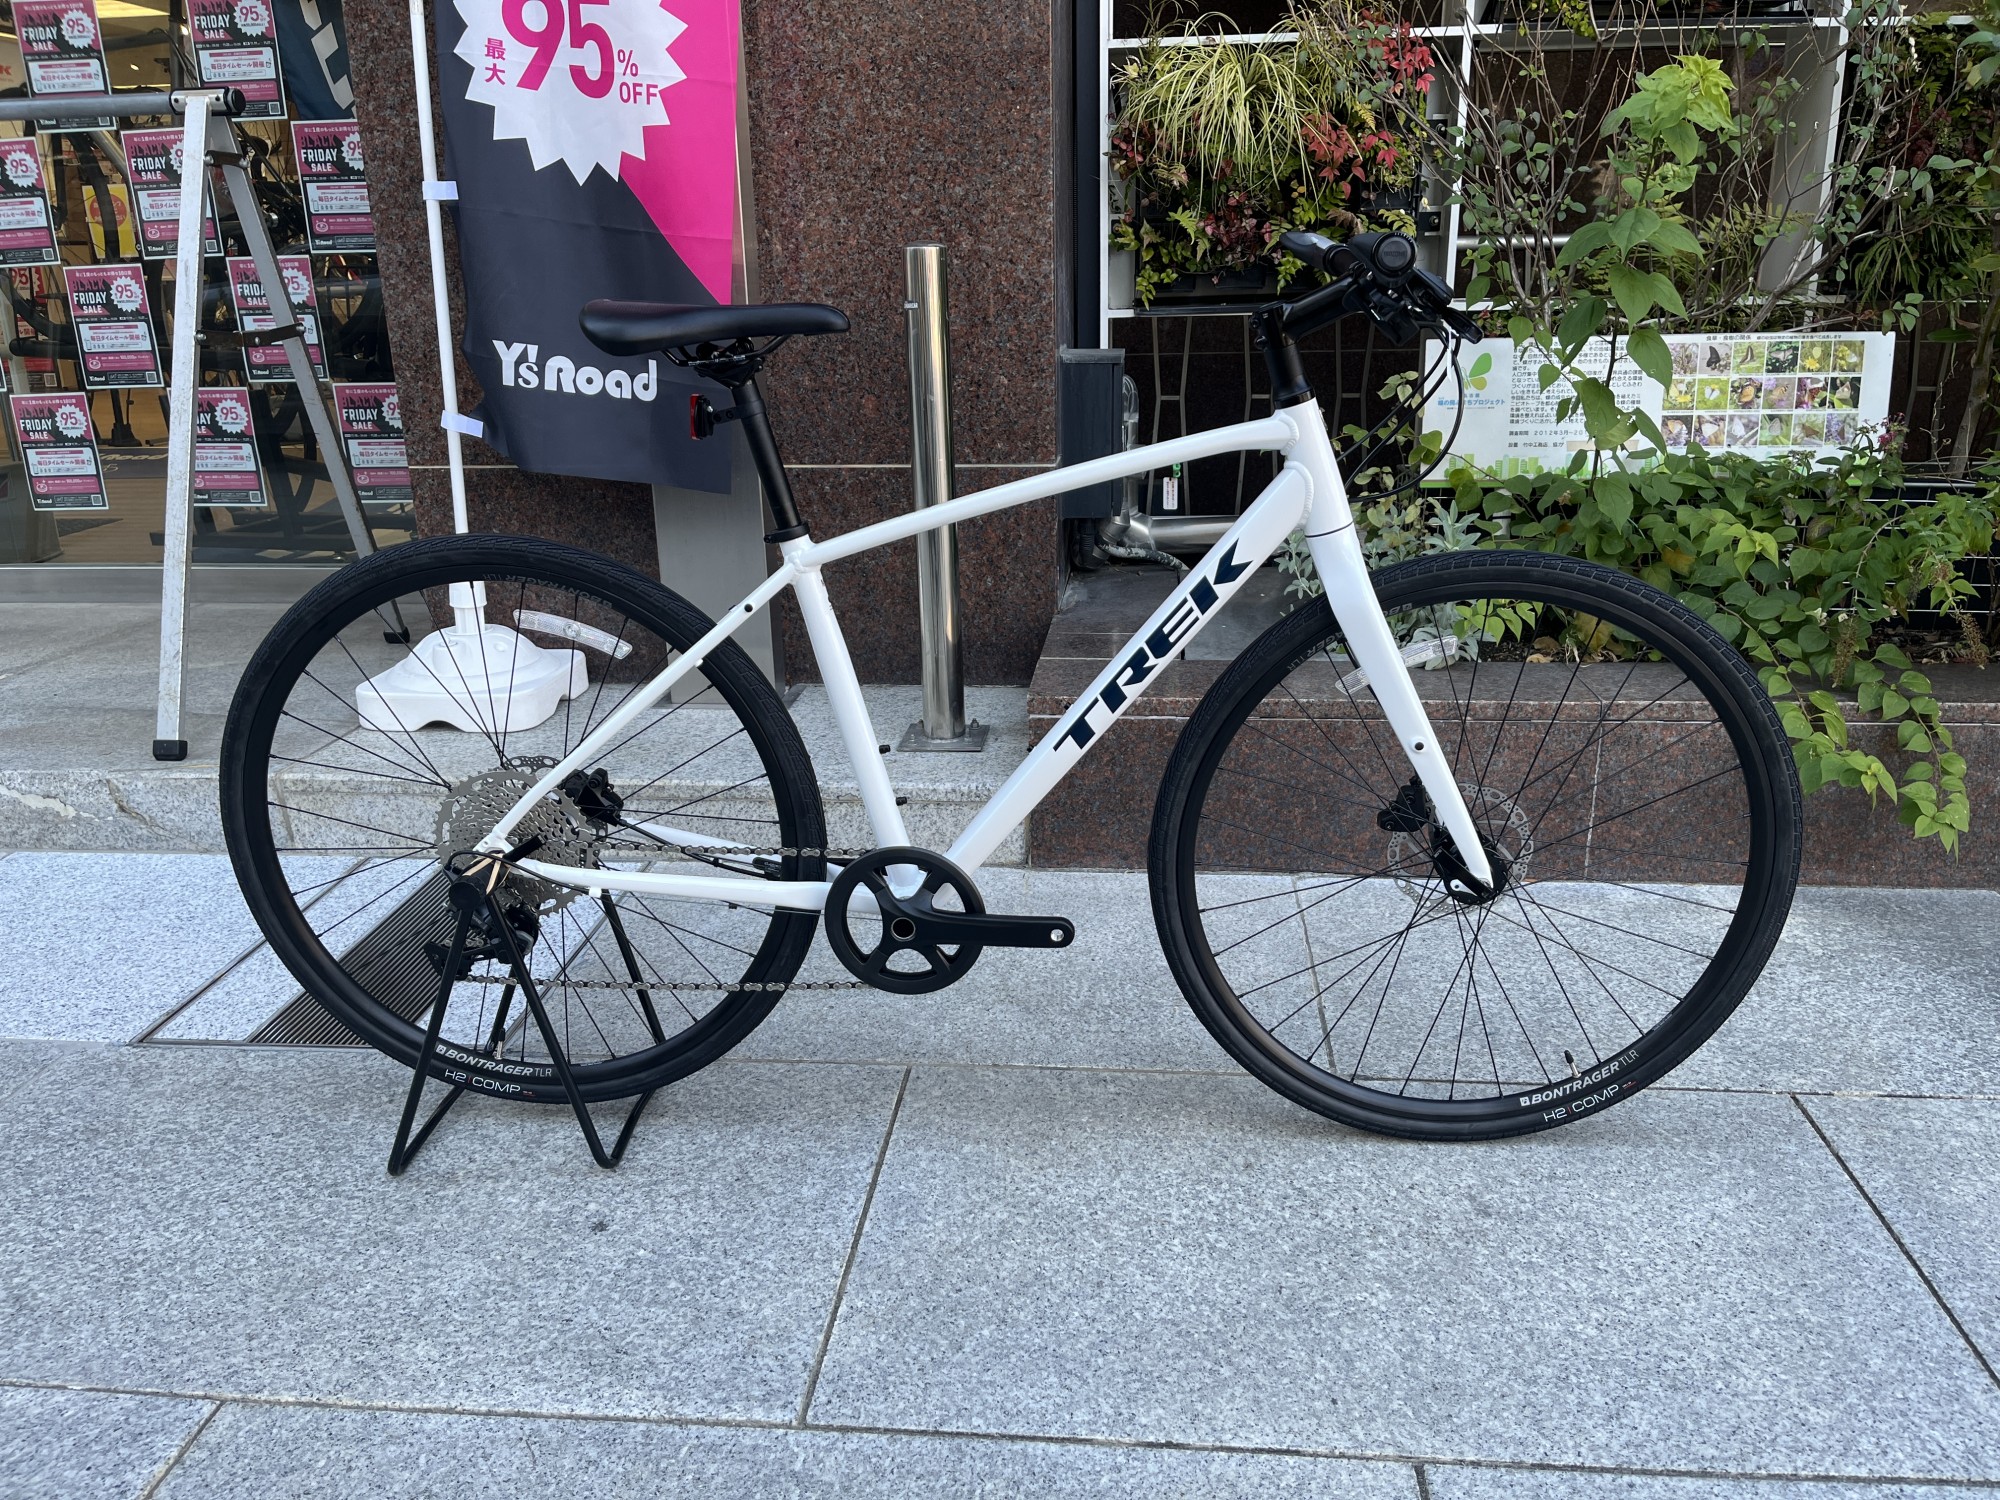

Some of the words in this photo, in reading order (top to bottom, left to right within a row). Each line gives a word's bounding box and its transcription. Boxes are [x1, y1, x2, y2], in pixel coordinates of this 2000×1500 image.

[193, 14, 230, 29] FRIDAY
[21, 26, 58, 41] FRIDAY
[204, 29, 225, 39] SALE
[33, 41, 54, 51] SALE
[484, 37, 507, 85] 最大
[619, 82, 659, 106] OFF
[301, 148, 337, 162] FRIDAY
[131, 156, 166, 171] FRIDAY
[311, 163, 332, 172] SALE
[141, 171, 162, 181] SALE
[237, 283, 266, 297] FRIDA
[73, 291, 107, 305] FRIDAY
[247, 297, 267, 306] SALE
[83, 305, 103, 314] SALE
[342, 408, 378, 420] FRIDAY
[20, 419, 52, 431] FRIDAY
[352, 421, 373, 430] SALE
[29, 431, 49, 440] SALE
[1052, 537, 1254, 753] TREK
[445, 1048, 534, 1077] BONTRAGER
[534, 1067, 552, 1078] TLR
[1531, 1060, 1620, 1105] BONTRAGER
[1618, 1049, 1640, 1066] TLR
[472, 1076, 521, 1094] COMP
[1572, 1084, 1619, 1113] COMP
